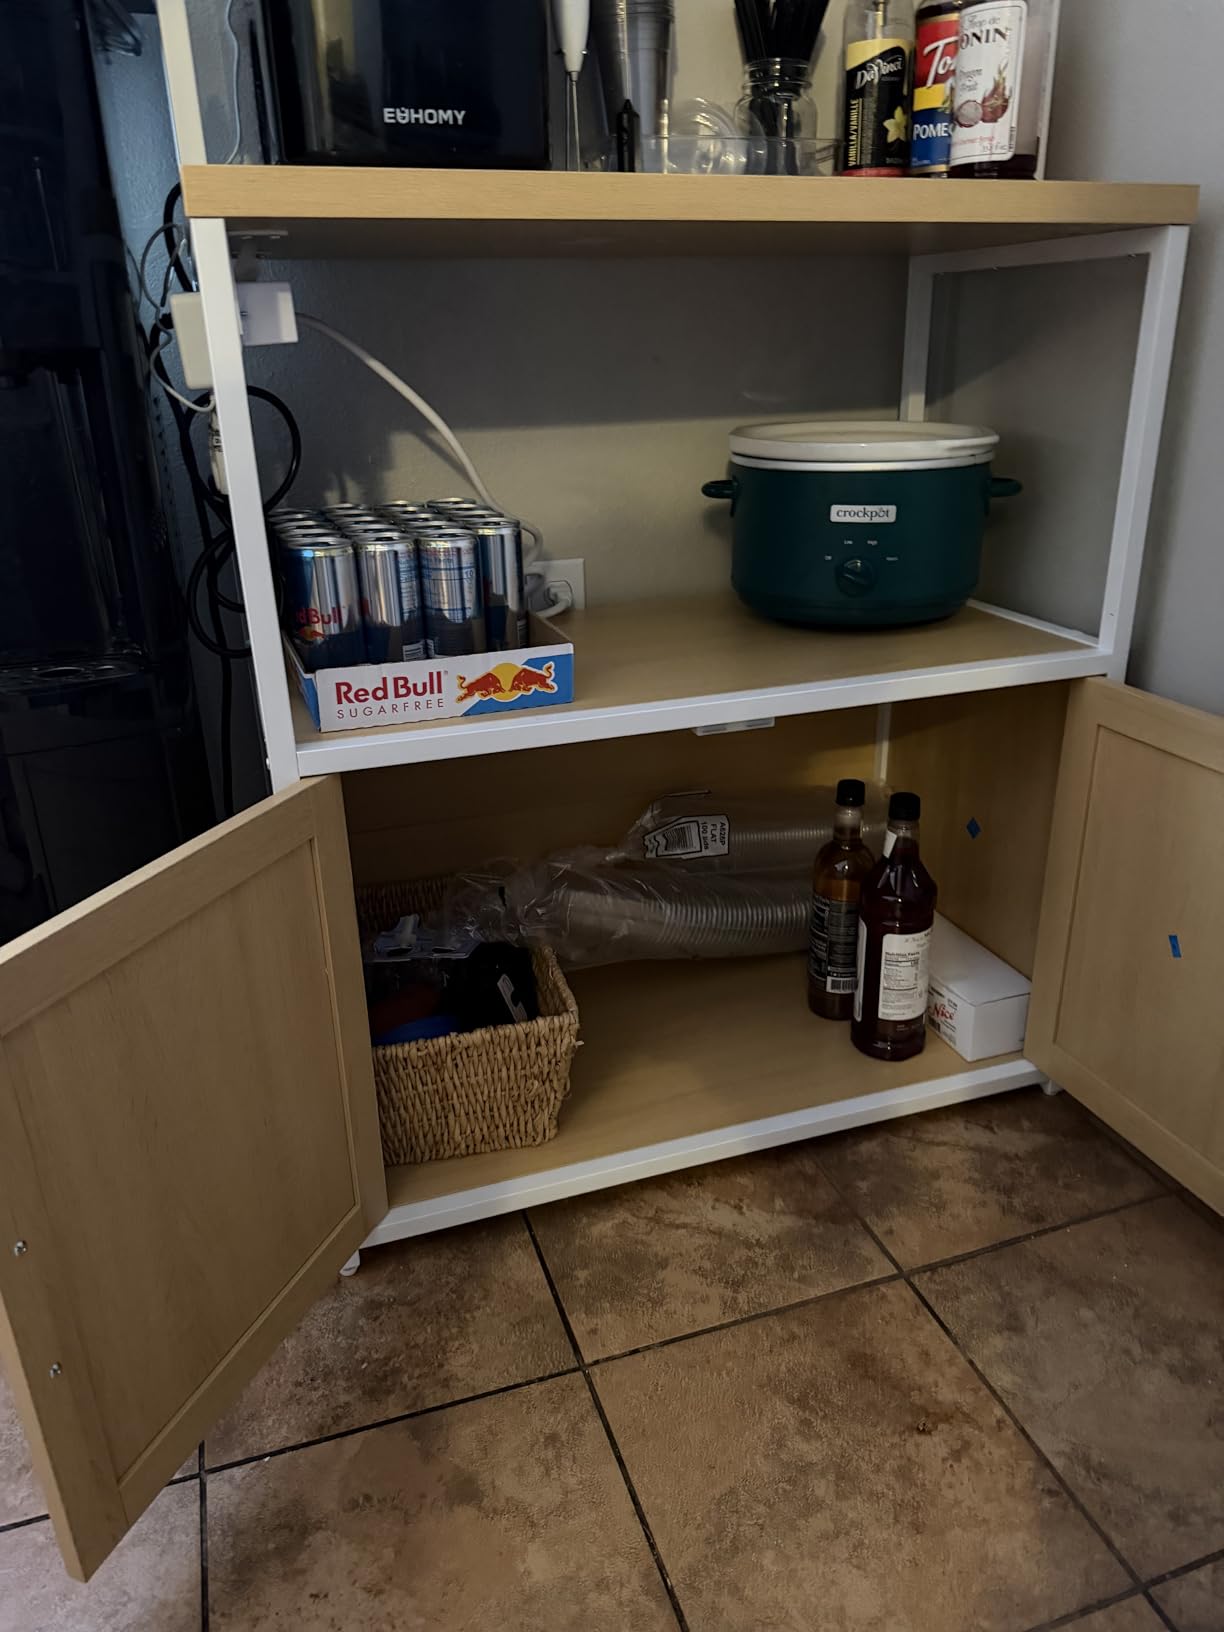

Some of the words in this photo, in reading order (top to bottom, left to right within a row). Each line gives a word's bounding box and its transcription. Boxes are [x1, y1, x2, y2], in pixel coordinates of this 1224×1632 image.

[960, 28, 1008, 50] ONIN
[383, 107, 466, 125] EUHOMY
[848, 99, 858, 167] VANILLA/VANILLE
[836, 507, 890, 521] crockpot
[335, 676, 388, 704] Red
[393, 671, 443, 698] Bull
[337, 699, 444, 719] SUGARFREE
